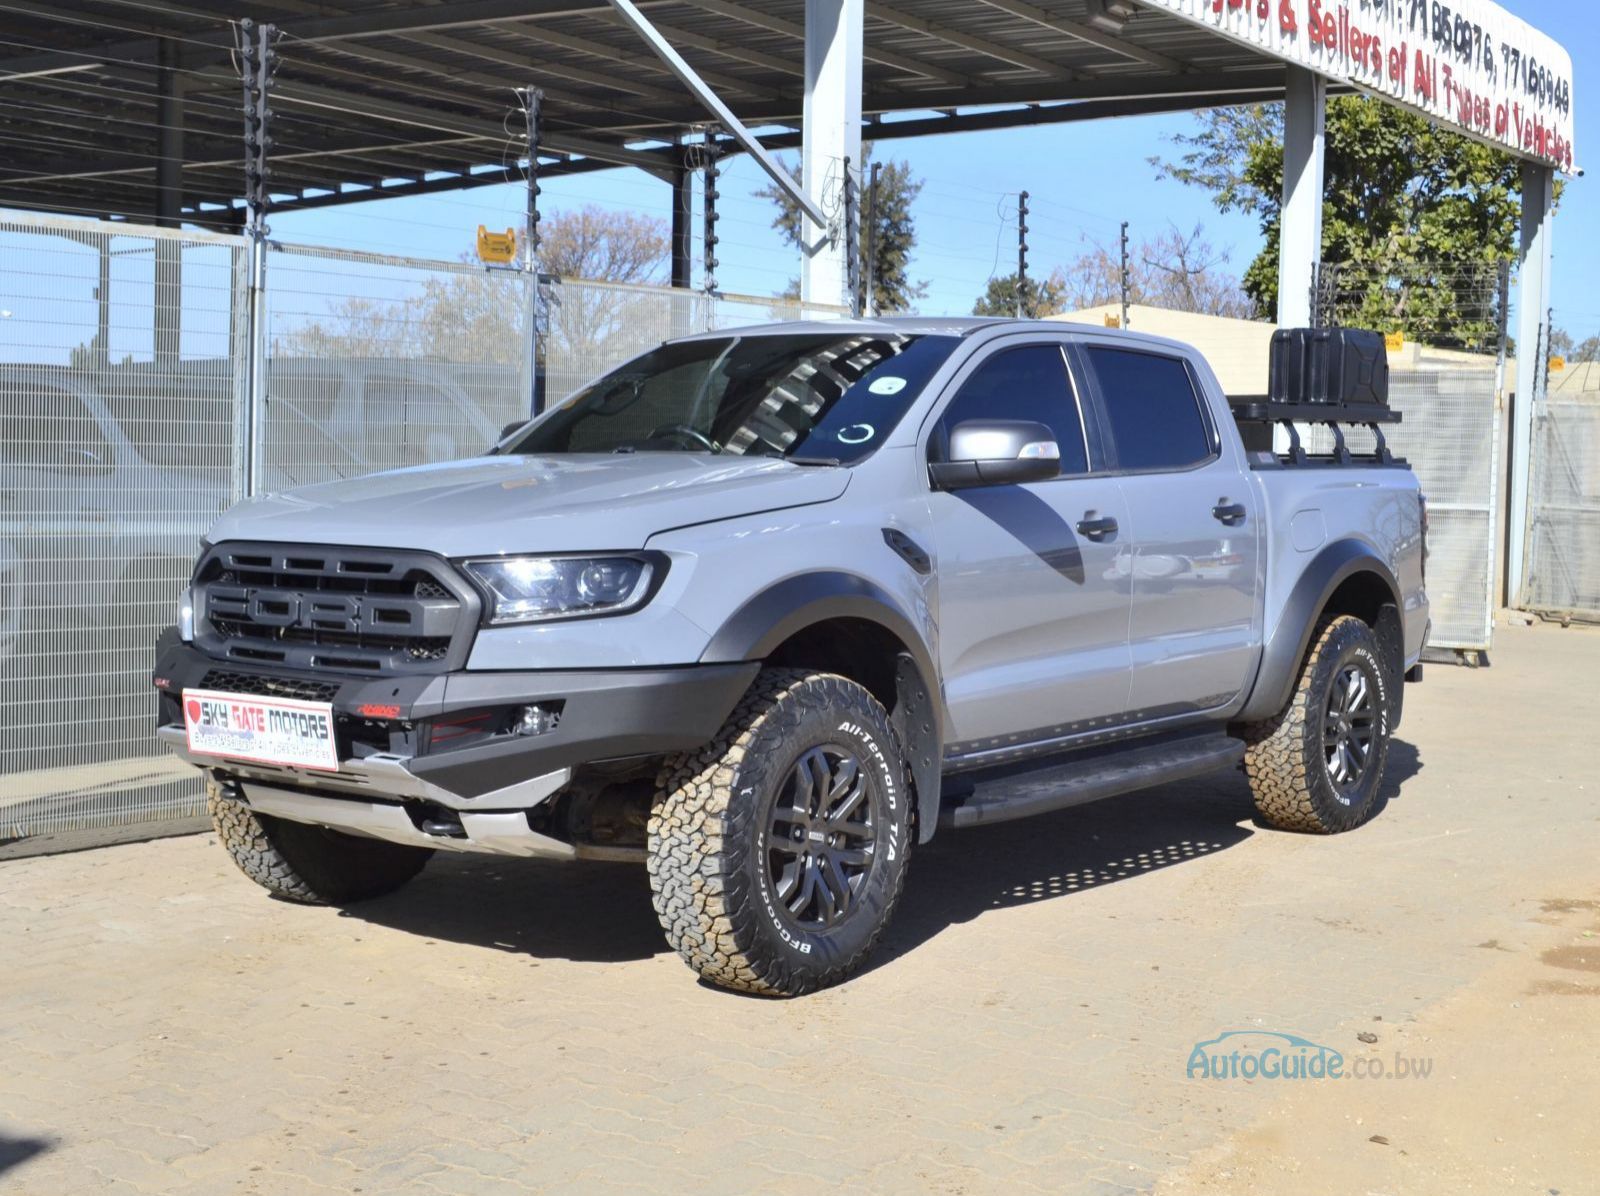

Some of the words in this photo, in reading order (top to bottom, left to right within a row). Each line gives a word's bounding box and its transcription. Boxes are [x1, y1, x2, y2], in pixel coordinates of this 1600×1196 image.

[1307, 0, 1382, 72] Sellers
[1388, 41, 1407, 83] of
[1413, 49, 1436, 100] All
[1442, 63, 1490, 131] Types
[1513, 102, 1572, 168] Vehicles
[201, 702, 228, 727] SKY
[231, 705, 265, 732] GATE
[268, 709, 329, 740] MOTORS
[1355, 648, 1385, 701] All-Terrain
[838, 721, 897, 810] All-Terrain
[887, 822, 899, 861] T/A
[757, 831, 811, 954] BFGoodrich
